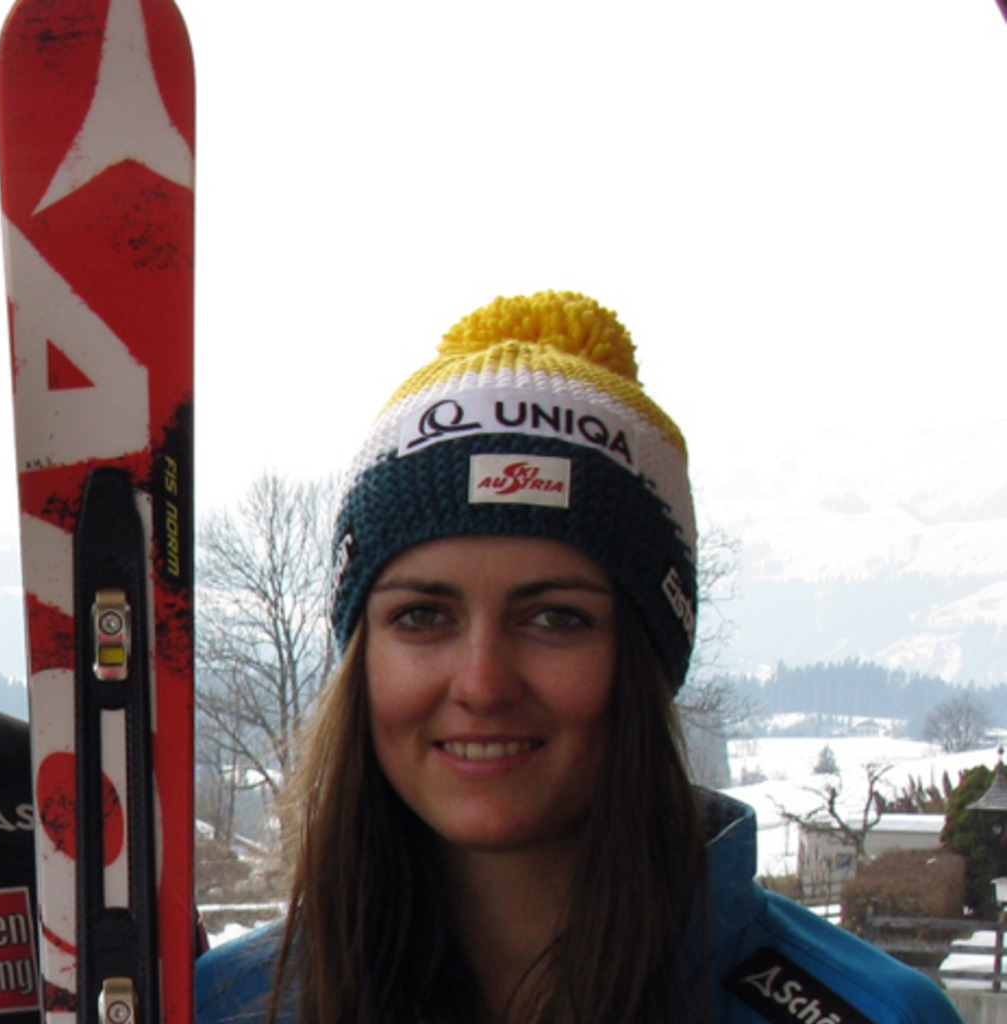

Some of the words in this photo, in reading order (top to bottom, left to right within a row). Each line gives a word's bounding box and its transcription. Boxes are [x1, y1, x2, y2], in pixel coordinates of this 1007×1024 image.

[495, 401, 633, 466] UNIQA
[164, 455, 179, 496] FIS
[477, 476, 566, 495] AUSTRIA
[165, 502, 181, 577] NORM
